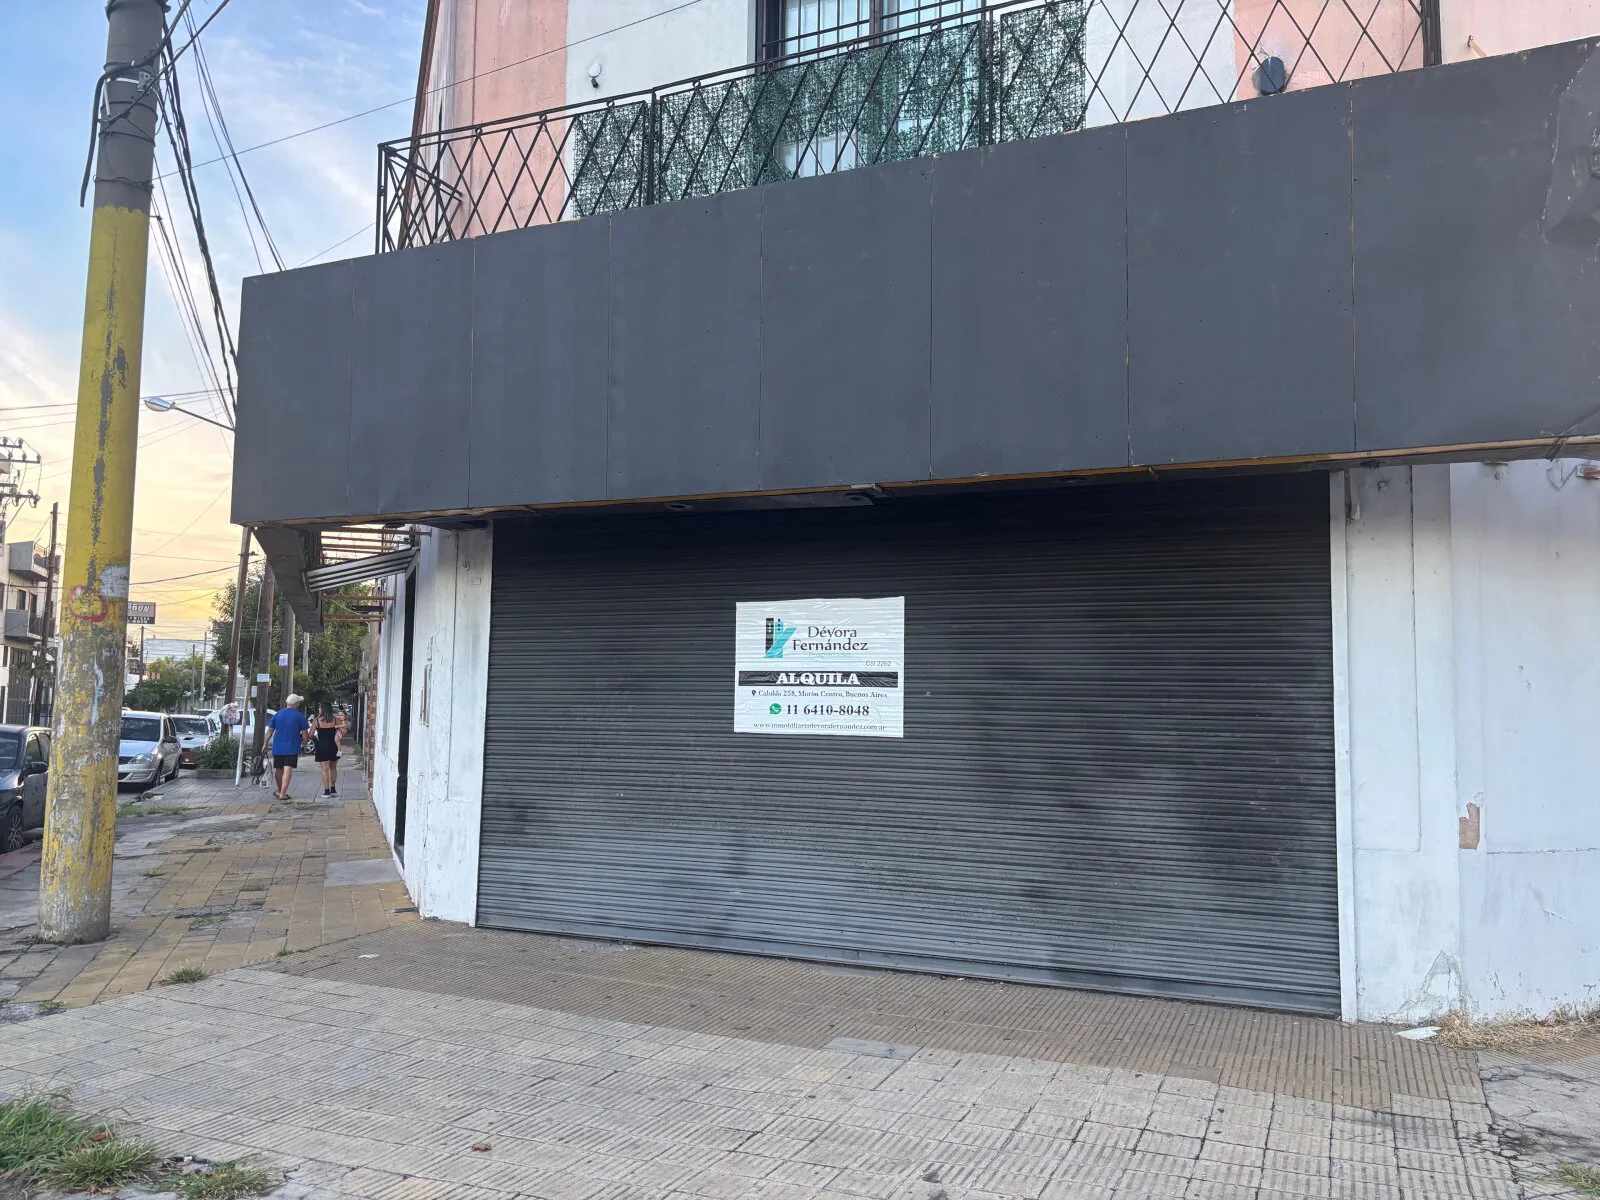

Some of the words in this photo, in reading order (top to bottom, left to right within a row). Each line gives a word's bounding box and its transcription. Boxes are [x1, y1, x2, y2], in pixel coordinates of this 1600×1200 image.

[808, 625, 857, 639] Dévora
[793, 638, 868, 651] Fernández
[776, 673, 860, 685] ALQUILA
[758, 689, 782, 697] Cabildo
[820, 690, 844, 698] Centro,
[787, 704, 798, 715] 11
[803, 704, 870, 716] 6410-8048
